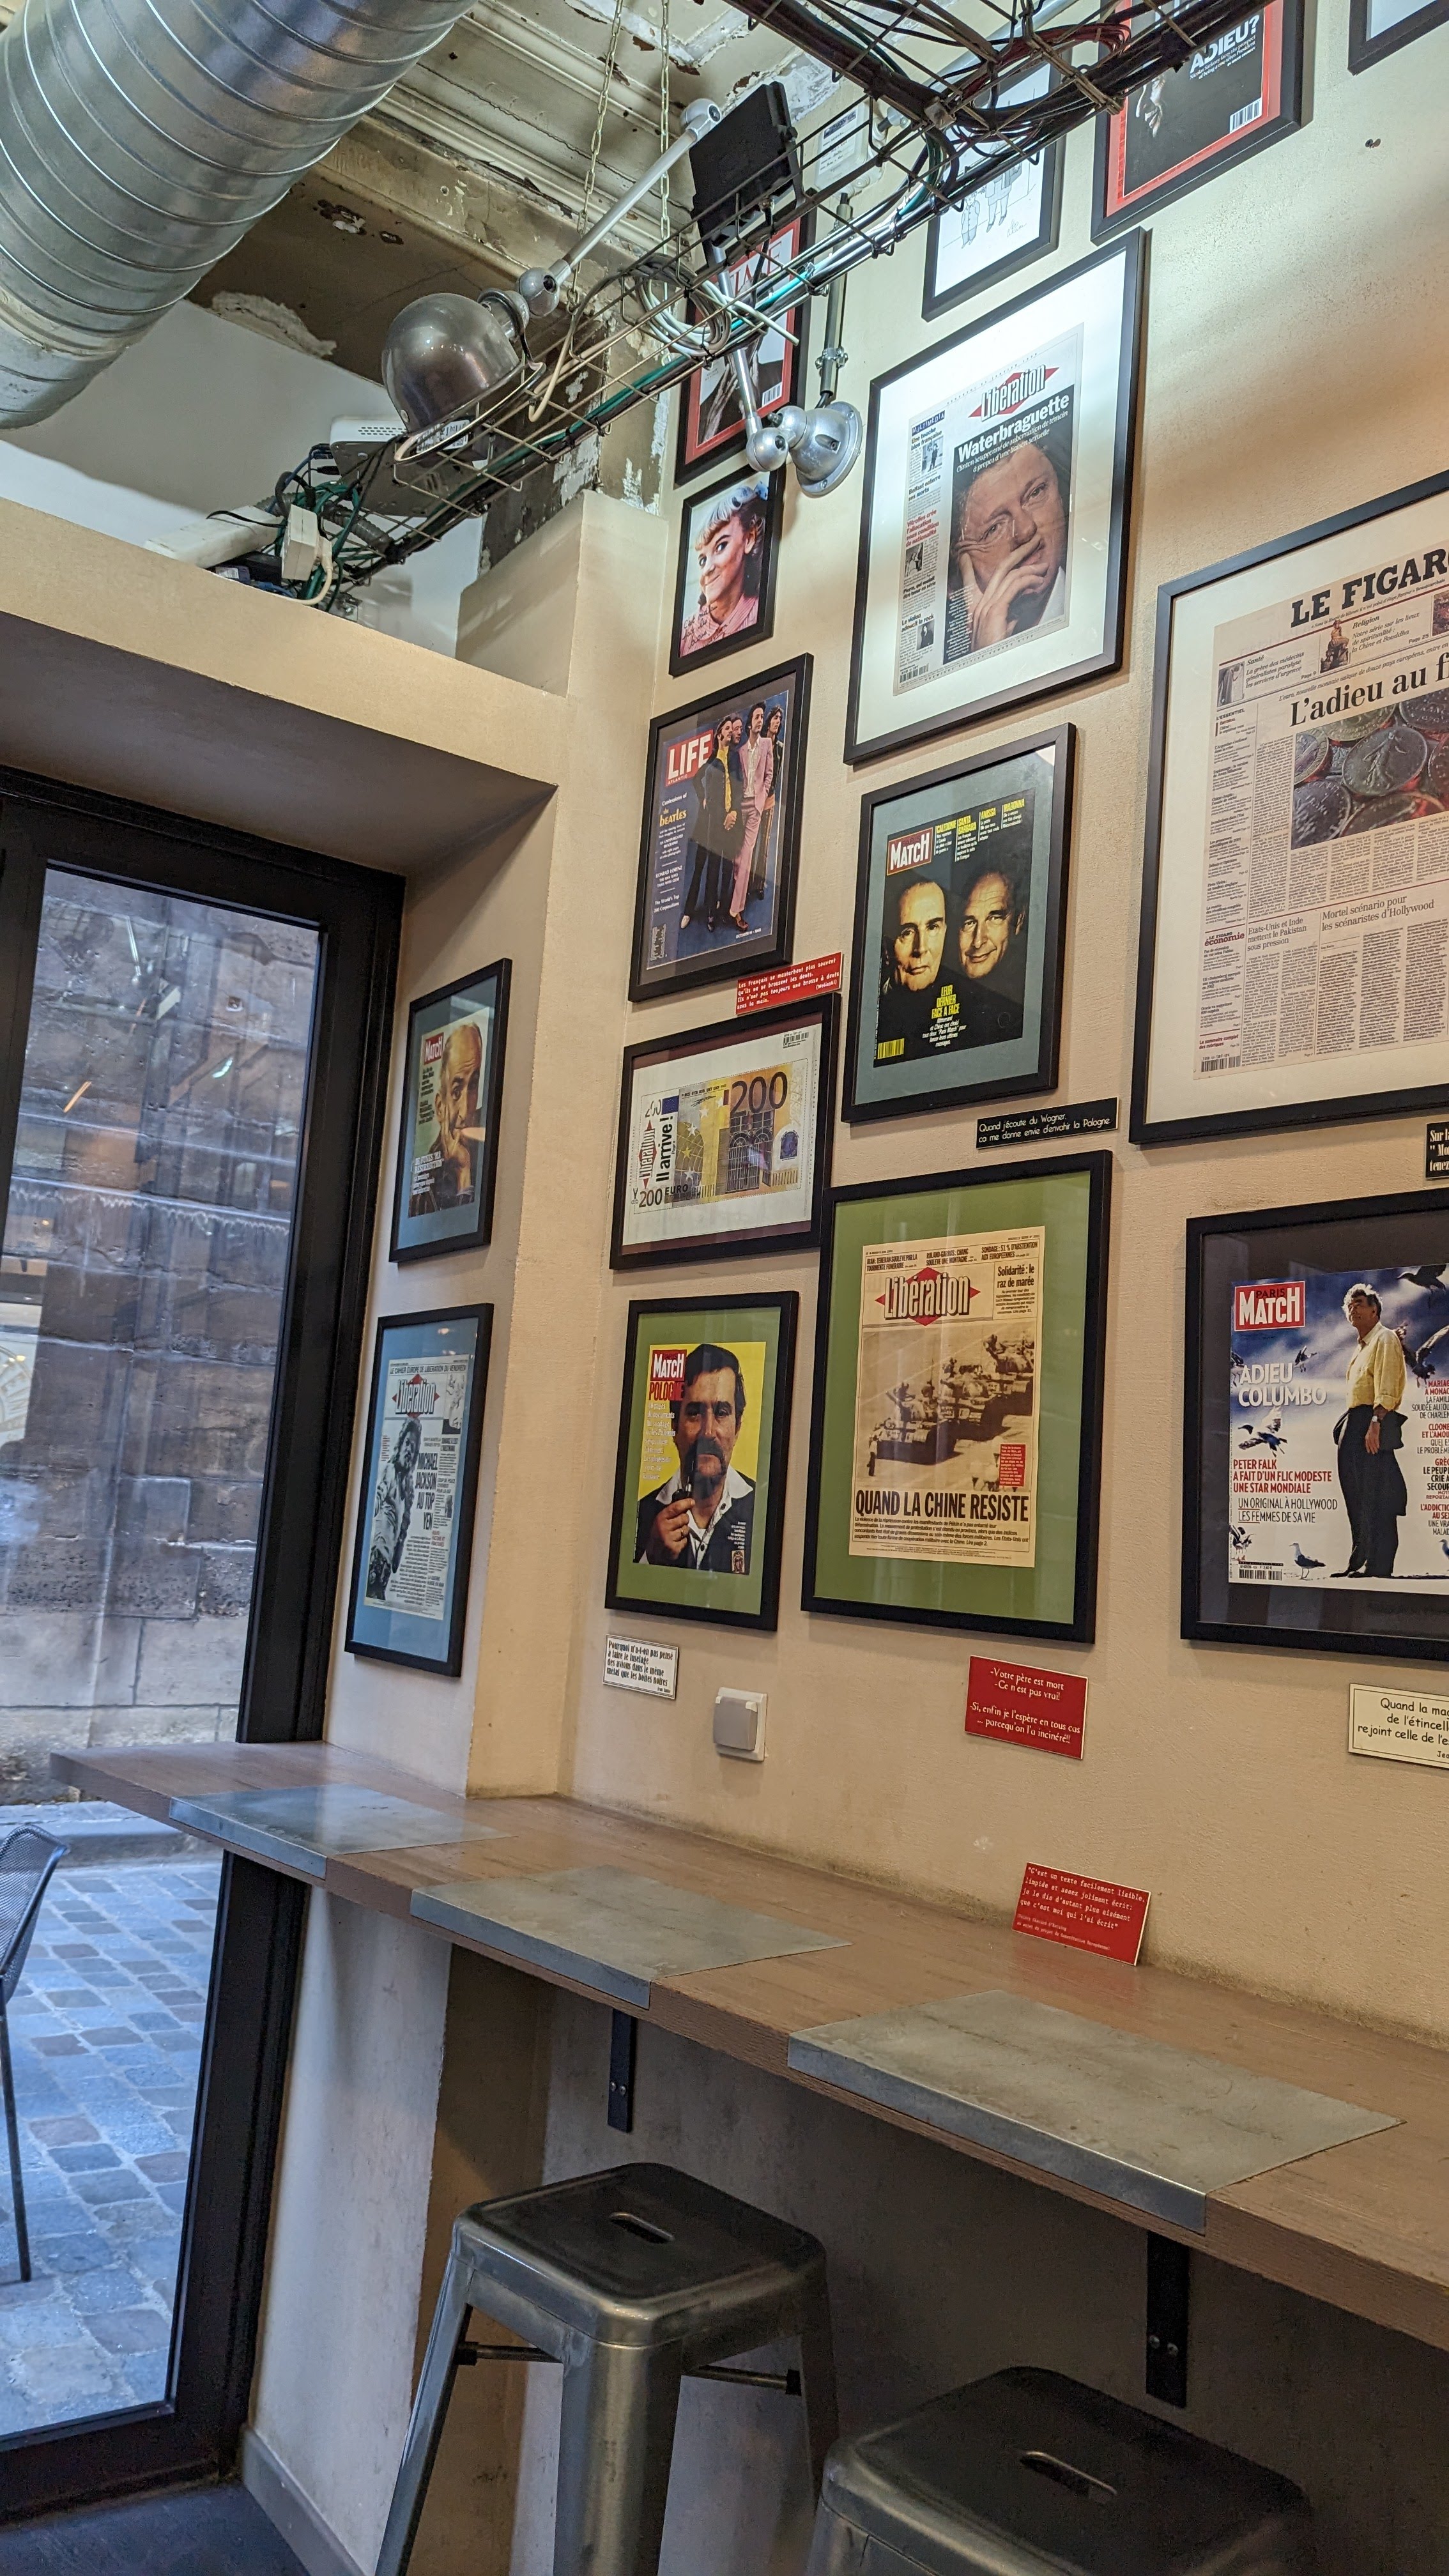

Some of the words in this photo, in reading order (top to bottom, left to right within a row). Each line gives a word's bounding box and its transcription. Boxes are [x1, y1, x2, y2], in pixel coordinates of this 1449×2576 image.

[1190, 15, 1260, 73] ADIEU?
[981, 364, 1046, 422] Libération
[958, 394, 1070, 463] Waterbraguette
[1291, 589, 1331, 628] LE
[1342, 548, 1449, 610] FIGAR
[1352, 615, 1380, 629] Religion
[1246, 654, 1264, 666] Santé
[1289, 680, 1384, 727] L'adieu
[1392, 667, 1428, 696] au
[668, 733, 712, 780] LIFE
[890, 832, 930, 871] MATCH
[1322, 906, 1349, 921] Mortel
[1350, 900, 1385, 915] scénario
[1387, 896, 1407, 909] pour
[1322, 922, 1333, 931] les
[1334, 912, 1379, 929] scénaristes
[1381, 899, 1434, 919] d'Hollywood
[1248, 922, 1280, 935] Etats-Unis
[1289, 917, 1303, 926] Inde
[1204, 931, 1245, 947] économie
[425, 1036, 443, 1062] MATCH
[730, 1071, 788, 1115] 200
[979, 1121, 1001, 1132] Quand
[1001, 1119, 1027, 1132] j'écoute
[1029, 1116, 1038, 1124] du
[1002, 1130, 1022, 1140] donne
[1023, 1128, 1040, 1137] envie
[1073, 1121, 1080, 1129] la
[657, 1123, 673, 1170] arrive
[1429, 1130, 1444, 1142] Sur
[638, 1188, 663, 1208] 200
[664, 1184, 688, 1195] EURO
[1029, 1264, 1035, 1274] le
[997, 1280, 1007, 1289] raz
[1008, 1279, 1015, 1287] de
[1016, 1276, 1034, 1287] marée
[1255, 1288, 1285, 1298] PARIS
[884, 1273, 971, 1321] Libération
[1239, 1287, 1300, 1326] MATCH
[652, 1353, 684, 1378] MATCH
[1239, 1362, 1293, 1385] ADIEU
[395, 1379, 436, 1414] Libération
[1238, 1385, 1327, 1407] COLUMBO
[418, 1452, 438, 1470] MICHAEL
[1233, 1459, 1257, 1469] PETER
[1258, 1459, 1277, 1469] FALK
[415, 1472, 438, 1490] JACKSON
[1233, 1471, 1238, 1481] A
[1239, 1471, 1256, 1482] FAIT
[1257, 1471, 1275, 1482] D'UN
[1277, 1471, 1293, 1482] FLIC
[1294, 1471, 1332, 1482] MODESTE
[1233, 1482, 1249, 1493] UNE
[1250, 1482, 1269, 1493] STAR
[1270, 1483, 1312, 1493] MONDIALE
[417, 1491, 425, 1508] AU
[425, 1492, 435, 1510] TOP
[855, 1489, 900, 1517] QUAND
[903, 1491, 921, 1517] LA
[924, 1492, 966, 1519] CHINE
[970, 1494, 1029, 1522] RESISTE
[1238, 1498, 1249, 1508] UN
[1250, 1498, 1283, 1509] ORIGINAL
[1291, 1498, 1338, 1510] HOLLYWOOD
[423, 1512, 433, 1530] YEN
[1238, 1511, 1250, 1522] LES
[1252, 1512, 1280, 1522] FEMMES
[1282, 1512, 1291, 1522] DE
[1292, 1512, 1303, 1522] SA
[1303, 1512, 1316, 1523] VIE
[650, 1650, 659, 1658] pas
[990, 1667, 1014, 1680] -Votre
[1016, 1673, 1032, 1685] père
[1046, 1681, 1064, 1690] mort
[994, 1680, 1008, 1690] -Ce
[1029, 1689, 1041, 1698] pas
[1043, 1691, 1061, 1701] vrai!
[1380, 1698, 1414, 1712] Quand
[1419, 1702, 1428, 1713] la
[983, 1705, 1001, 1716] enfin
[1003, 1709, 1009, 1719] je
[1011, 1710, 1038, 1724] l'espère
[1050, 1721, 1066, 1731] tous
[1068, 1725, 1080, 1733] cas
[985, 1719, 1025, 1733] parcequ'on
[1027, 1725, 1036, 1736] l'a
[1387, 1713, 1400, 1724] de
[1404, 1715, 1449, 1732] l'étincell
[1358, 1725, 1392, 1738] rejoint
[1395, 1729, 1418, 1741] celle
[1421, 1732, 1434, 1743] de
[1438, 1733, 1449, 1745] l'e
[1025, 1877, 1048, 1889] limpide
[1061, 1887, 1078, 1896] assez
[1081, 1892, 1109, 1905] joliment
[1061, 1875, 1078, 1885] texte
[1080, 1880, 1115, 1894] facilement
[1020, 1899, 1031, 1907] que
[1032, 1901, 1050, 1912] c'est
[1052, 1907, 1064, 1915] moi
[1066, 1910, 1077, 1920] qui
[1080, 1913, 1094, 1924] l'ai
[1042, 1892, 1052, 1901] dis
[1055, 1896, 1083, 1909] d'autant
[1085, 1905, 1100, 1915] plus
[1102, 1908, 1131, 1922] aisément
